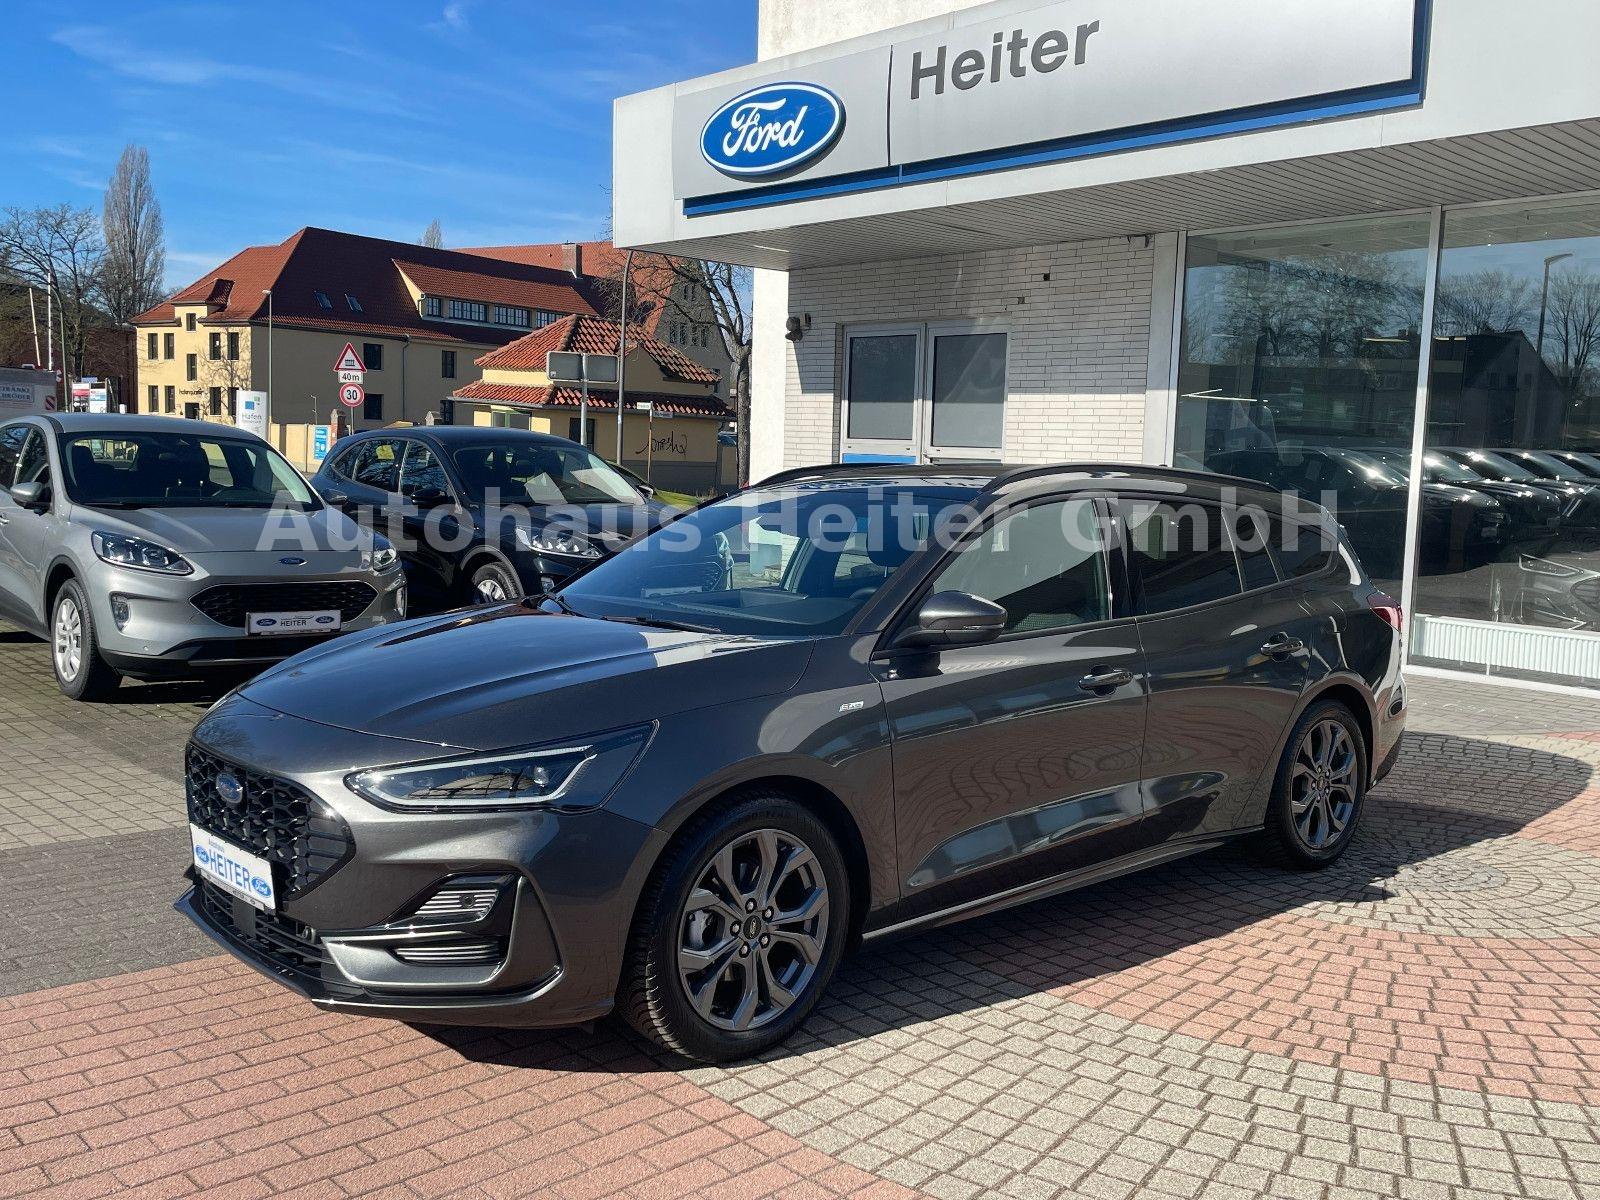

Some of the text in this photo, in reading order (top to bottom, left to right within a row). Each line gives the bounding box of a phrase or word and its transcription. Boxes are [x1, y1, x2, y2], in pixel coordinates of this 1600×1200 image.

[909, 19, 1100, 101] Heiter
[722, 97, 809, 157] Ford
[346, 389, 358, 400] 30
[208, 849, 252, 892] HEITER
[254, 879, 270, 894] Ford
